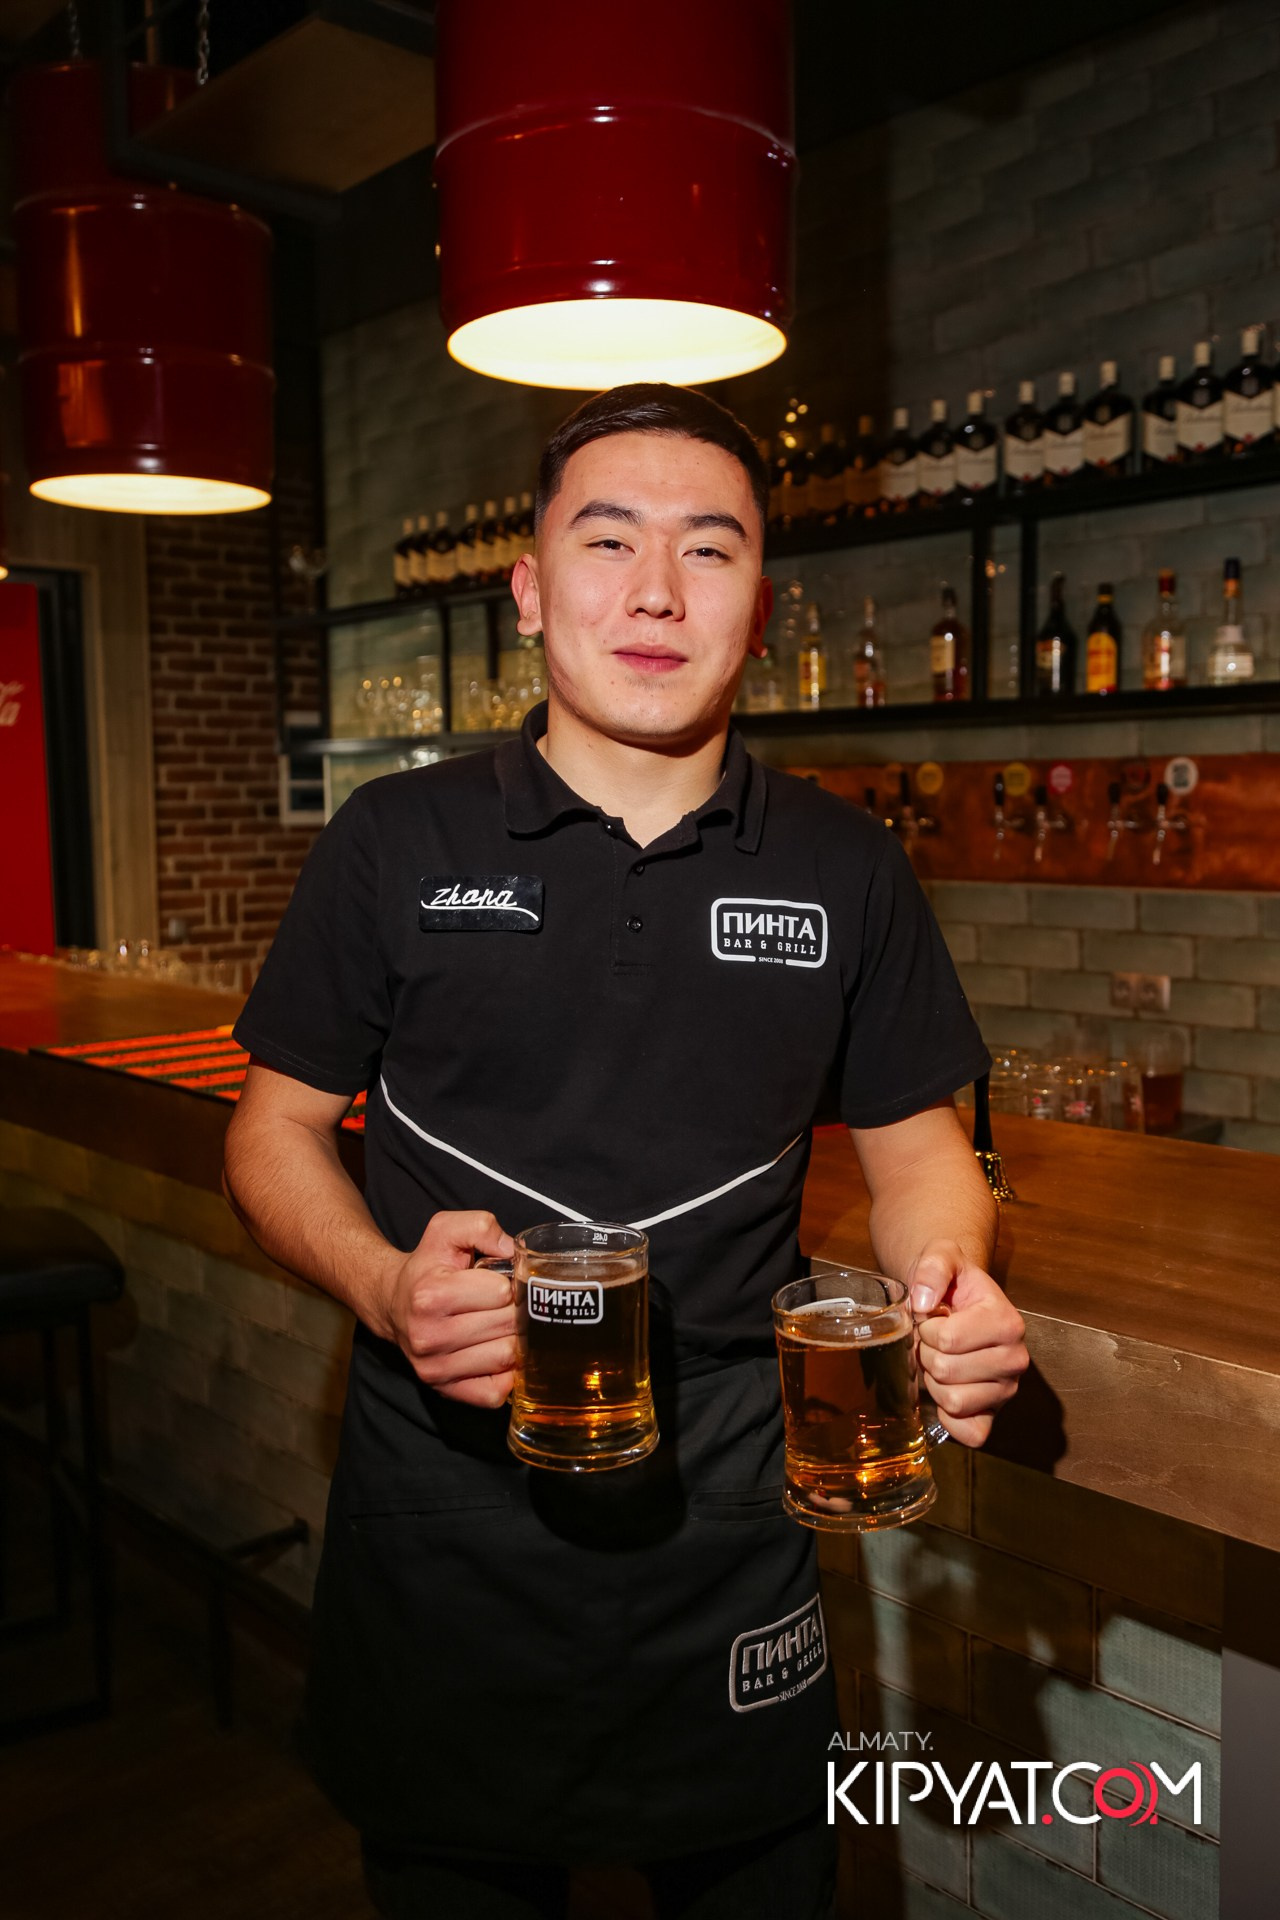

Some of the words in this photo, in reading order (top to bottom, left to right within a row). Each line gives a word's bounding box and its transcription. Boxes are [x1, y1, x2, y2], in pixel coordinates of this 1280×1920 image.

[723, 912, 817, 941] ПИНТА
[724, 938, 752, 949] BAR
[760, 940, 767, 950] &
[777, 941, 816, 955] GRILL
[532, 1286, 596, 1307] ПИНТА
[533, 1303, 549, 1314] BAR
[565, 1308, 596, 1316] GRILL
[742, 1613, 820, 1675] ПИНТА
[742, 1673, 774, 1692] BAR
[781, 1667, 789, 1680] &
[797, 1642, 822, 1672] GRILL
